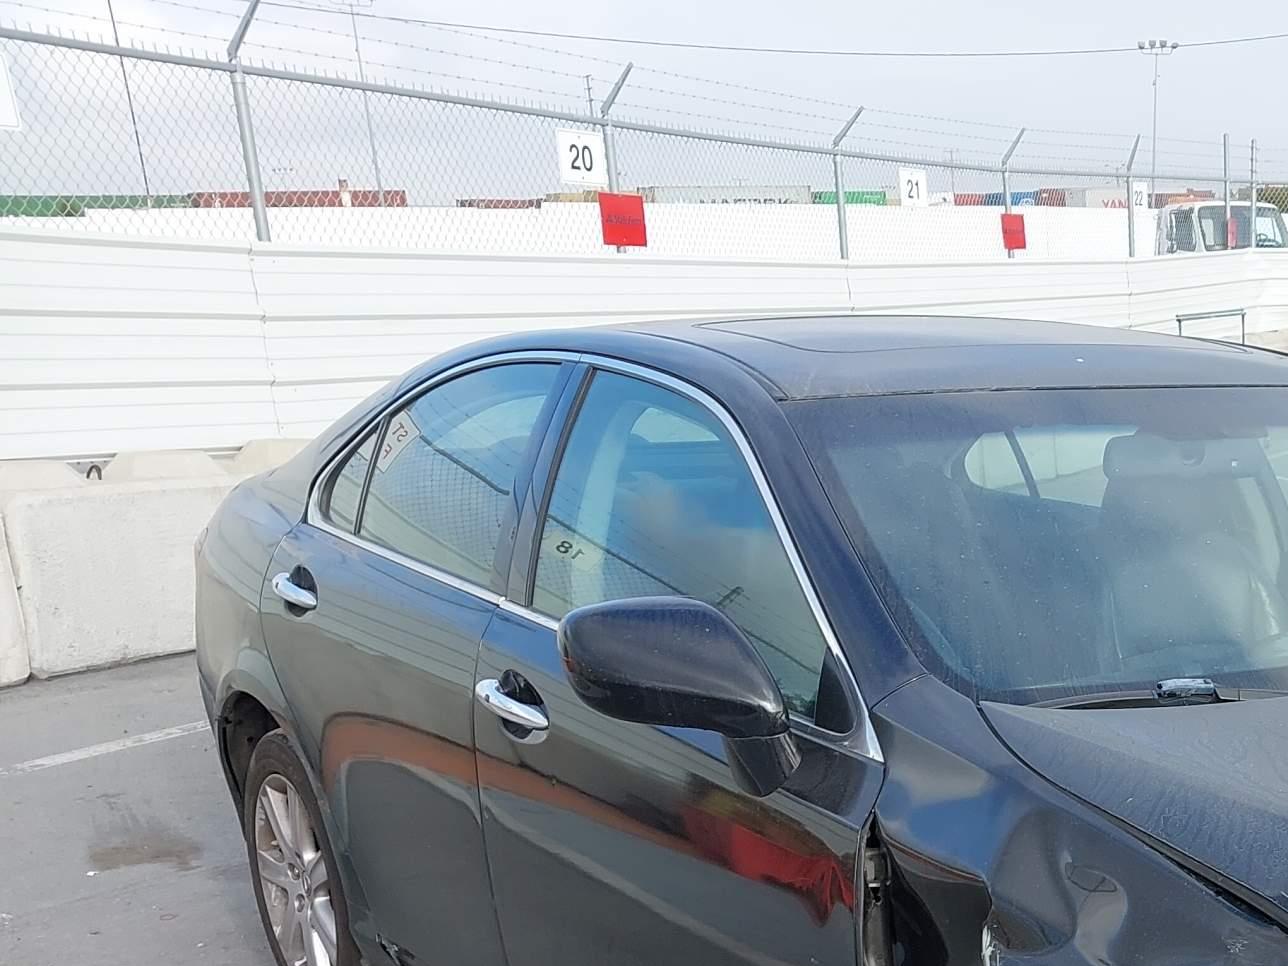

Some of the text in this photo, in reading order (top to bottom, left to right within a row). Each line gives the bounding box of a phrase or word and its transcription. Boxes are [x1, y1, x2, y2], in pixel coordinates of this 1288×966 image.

[569, 143, 593, 172] 20
[906, 179, 920, 199] 21
[1134, 190, 1144, 206] 22
